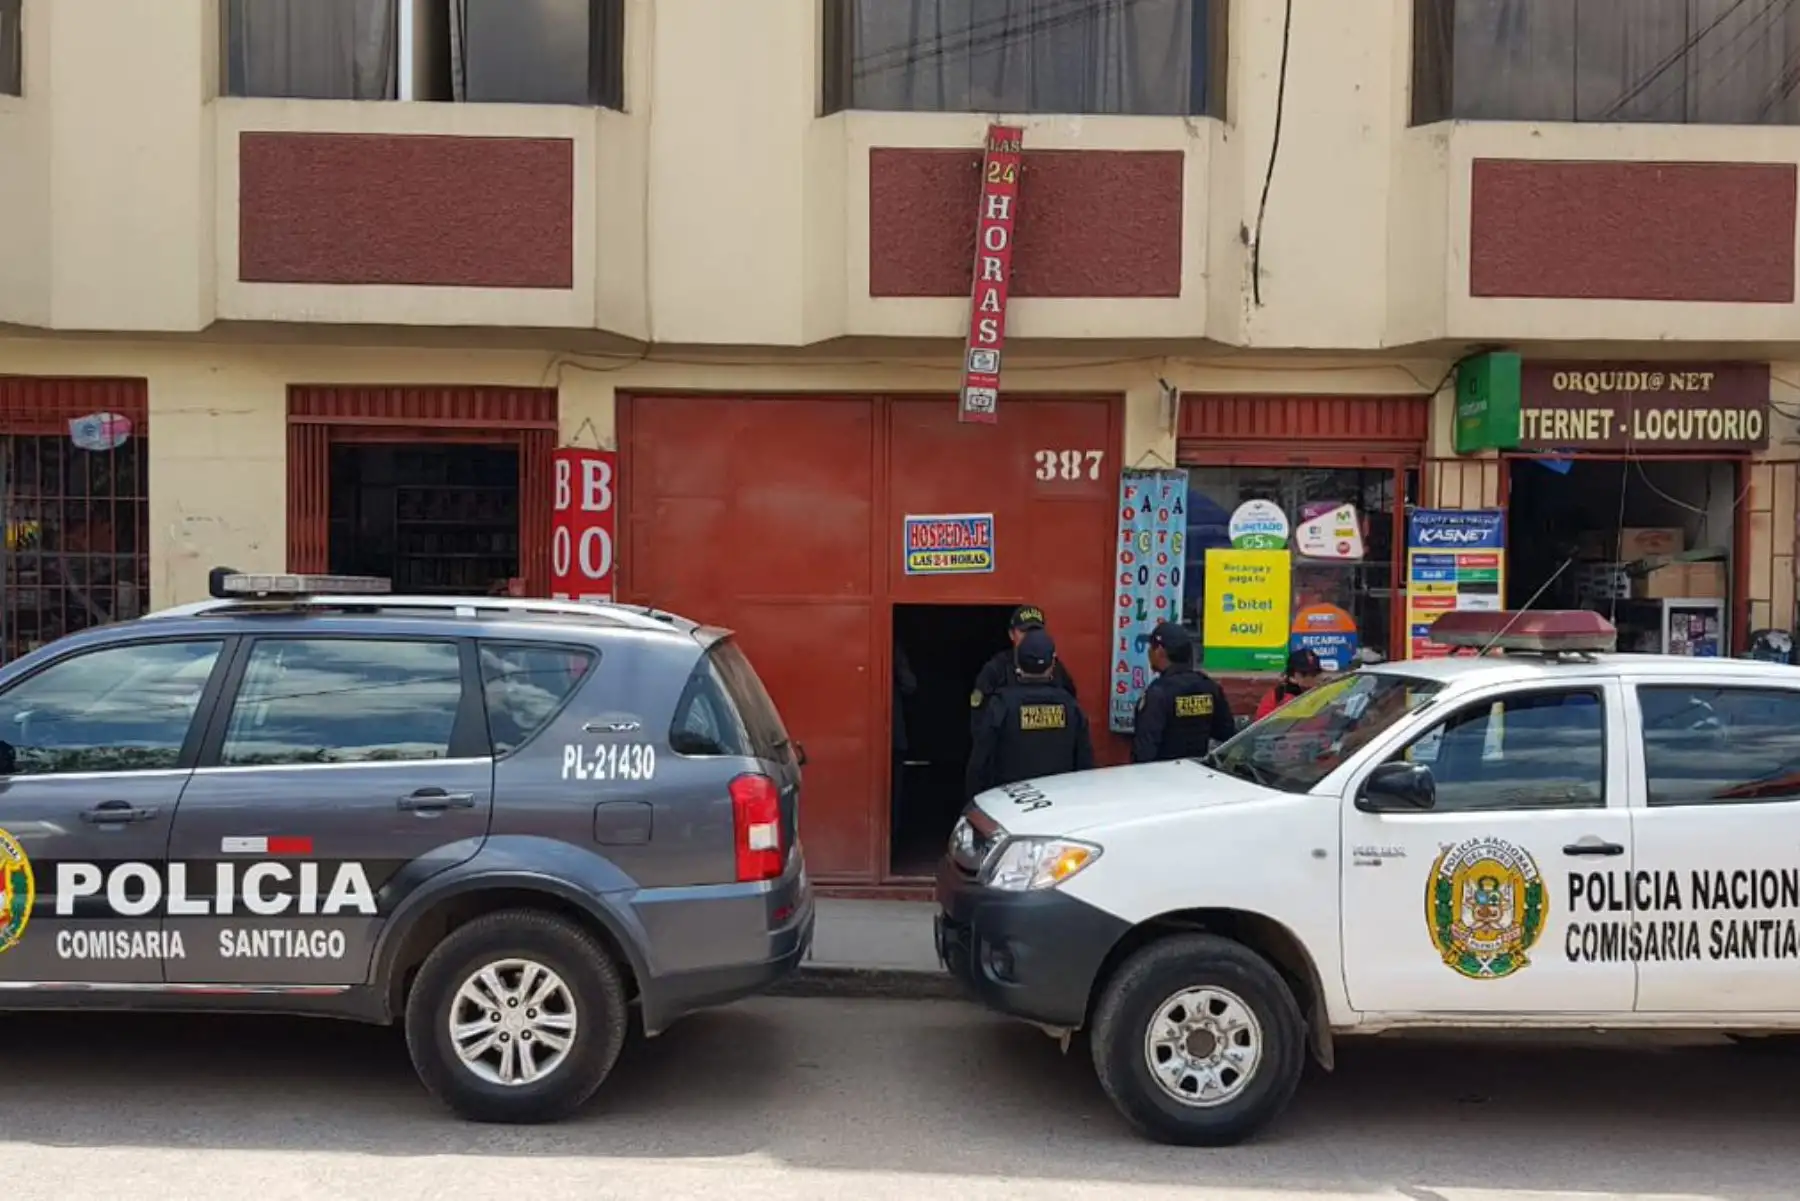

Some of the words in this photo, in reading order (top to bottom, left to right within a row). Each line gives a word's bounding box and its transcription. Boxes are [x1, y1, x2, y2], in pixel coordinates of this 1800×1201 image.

[989, 138, 1020, 152] LAS
[987, 160, 1016, 183] 24
[979, 194, 1011, 343] HORAS
[1552, 371, 1664, 394] ORQUIDI@
[1669, 372, 1714, 391] NET
[1634, 408, 1762, 440] LOCUTORIO
[1034, 450, 1104, 481] 387
[911, 521, 990, 548] HOSPEDAJE
[1419, 528, 1493, 543] KASNET
[913, 555, 931, 566] LAS
[933, 555, 948, 566] 24
[951, 552, 986, 565] HORAS
[1223, 563, 1264, 575] Recarga
[1228, 575, 1252, 585] paga
[1237, 598, 1272, 611] bitel
[1302, 635, 1347, 646] RECARGA
[562, 743, 655, 780] PL-21430
[56, 861, 378, 916] POLICIA
[1568, 870, 1682, 912] POLICIA
[57, 930, 186, 959] COMISARIA
[219, 929, 346, 959] SANTIAGO
[1565, 920, 1701, 962] COMISARIA
[1708, 918, 1800, 960] SANTIA
